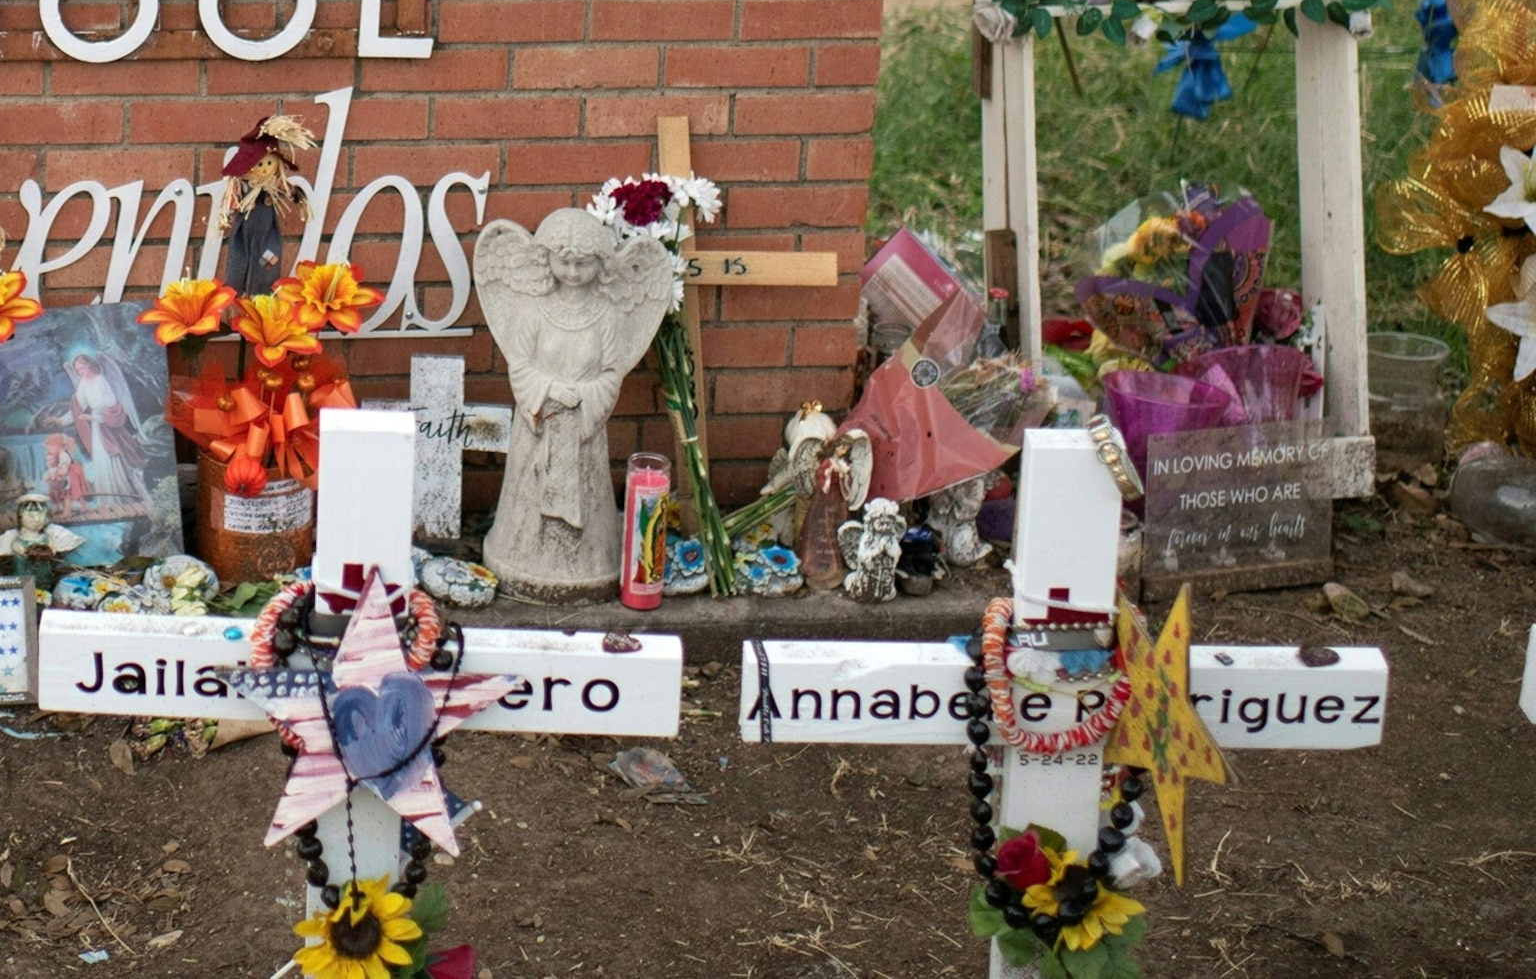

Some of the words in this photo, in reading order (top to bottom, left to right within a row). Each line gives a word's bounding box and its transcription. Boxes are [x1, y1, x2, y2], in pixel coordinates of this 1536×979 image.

[724, 257, 747, 276] IS
[1153, 459, 1170, 476] IN
[1173, 452, 1233, 474] LOVING
[1236, 445, 1305, 467] MEMORY
[1308, 443, 1330, 460] OF
[1179, 490, 1226, 510] THOSE
[1230, 485, 1268, 504] WHO
[1272, 482, 1302, 500] ARE
[1268, 511, 1306, 539] hearts
[76, 651, 248, 697] Jaila
[1019, 753, 1098, 766] 5-24-22
